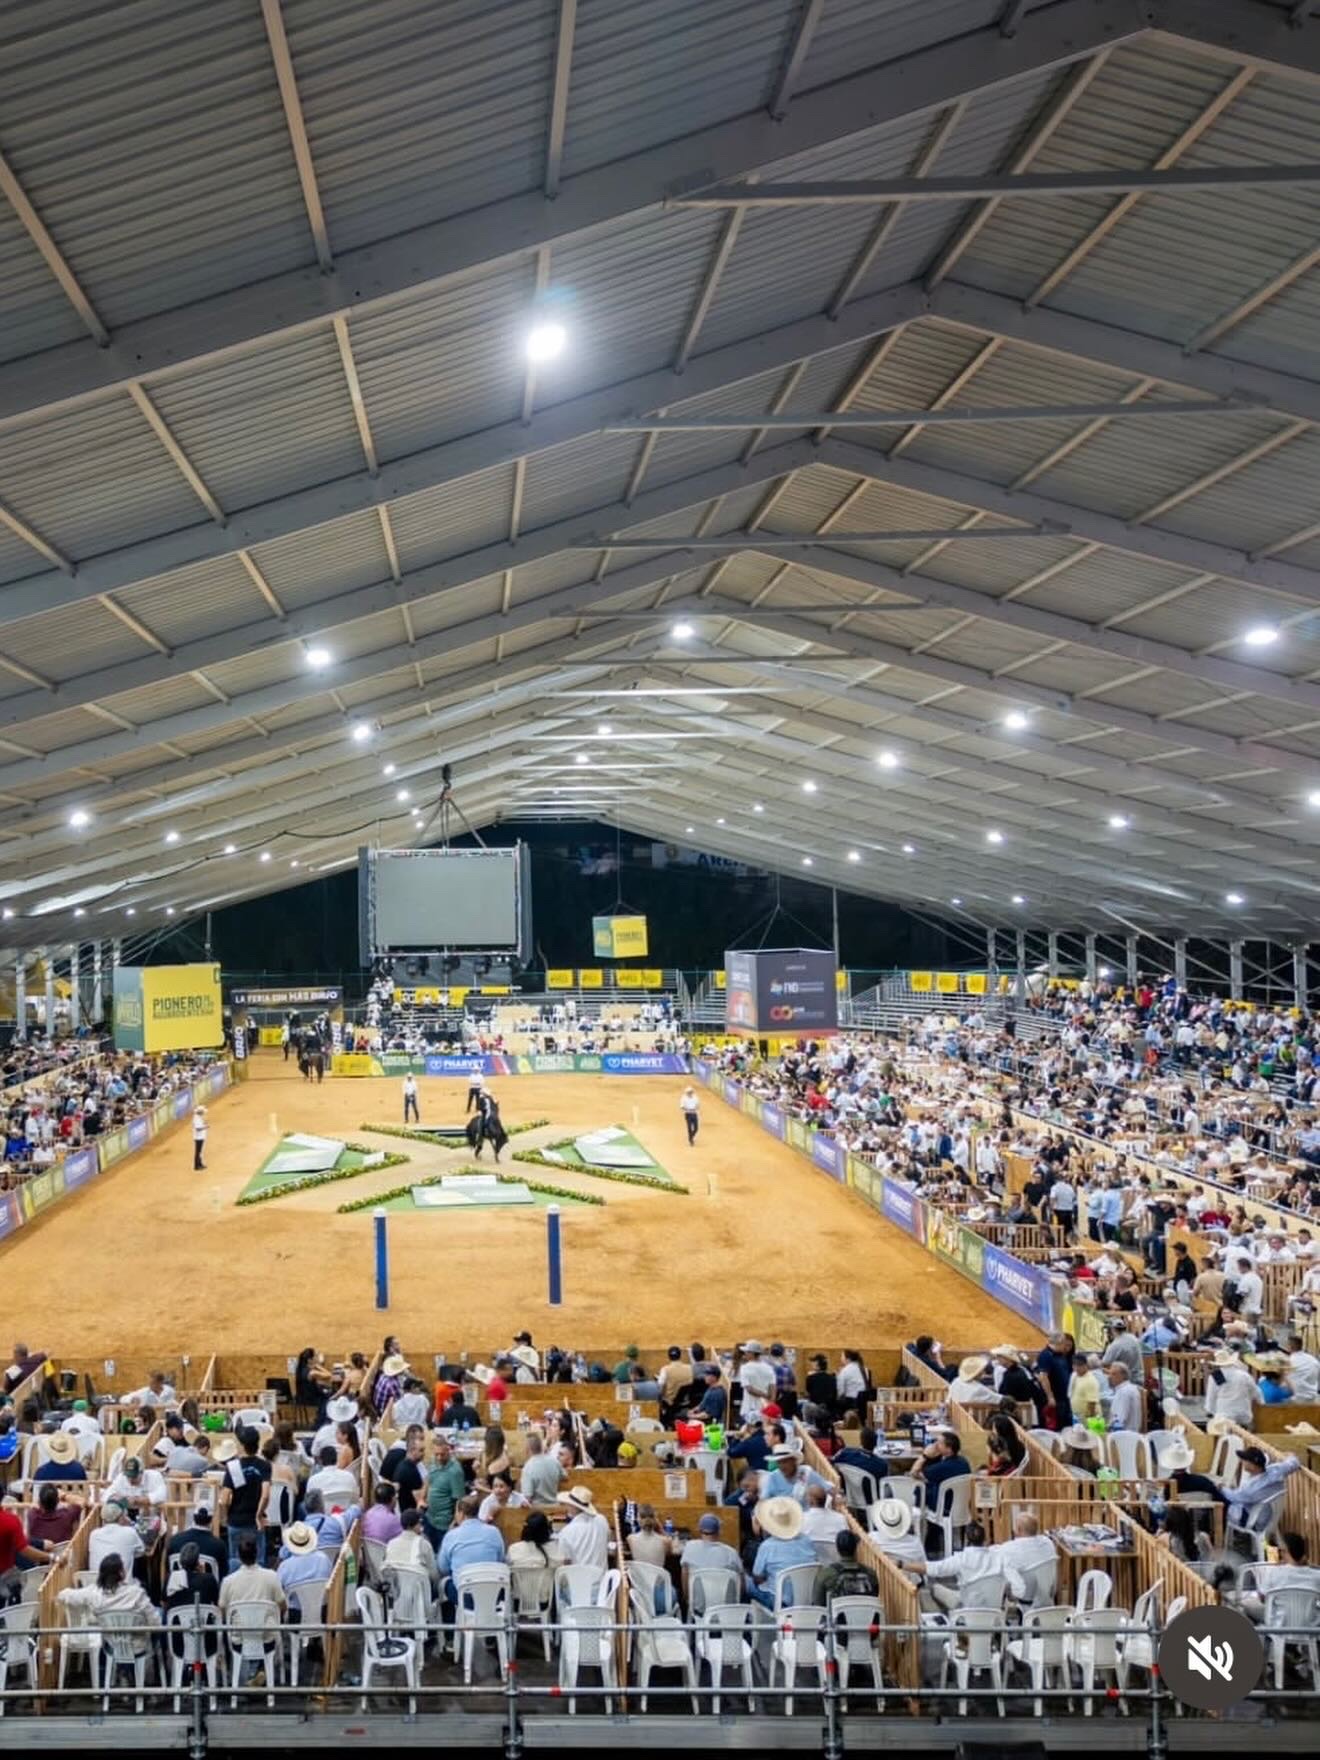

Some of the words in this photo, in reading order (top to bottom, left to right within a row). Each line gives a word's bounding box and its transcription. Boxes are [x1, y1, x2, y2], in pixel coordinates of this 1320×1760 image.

[152, 995, 203, 1012] PIONERO
[235, 994, 245, 1003] LA
[443, 1059, 485, 1068] PHARVET
[621, 1057, 664, 1068] PHARVET
[997, 1262, 1034, 1299] PHARVET
